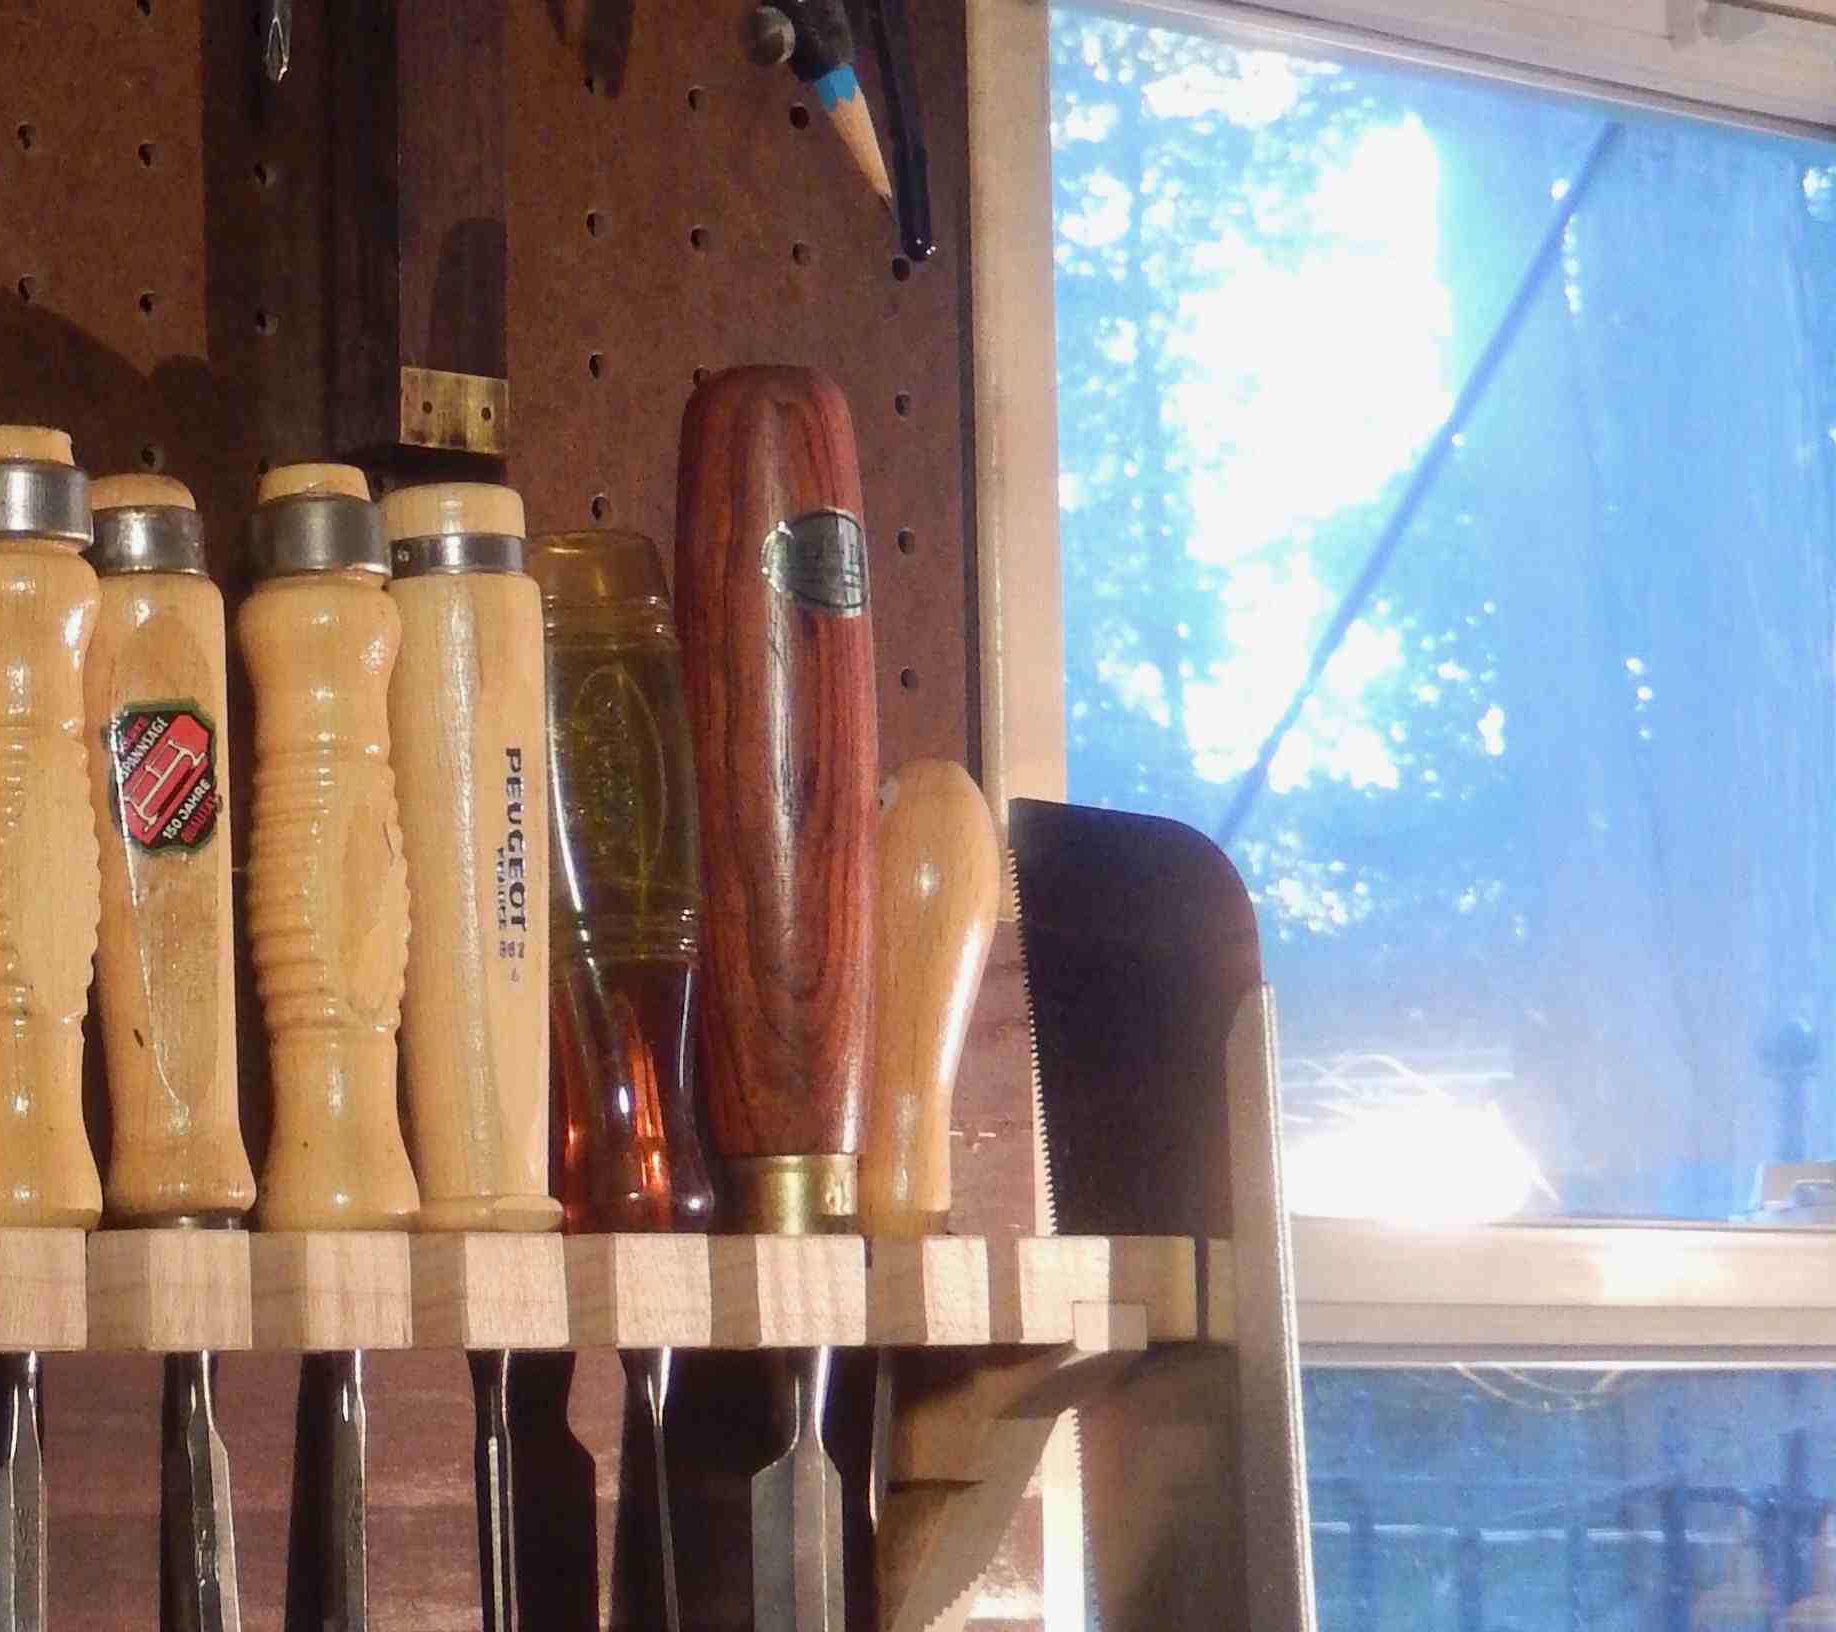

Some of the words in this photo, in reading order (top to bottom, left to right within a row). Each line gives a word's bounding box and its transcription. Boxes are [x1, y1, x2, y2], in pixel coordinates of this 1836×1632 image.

[162, 818, 183, 839] 150
[178, 778, 212, 821] JAHRE
[505, 747, 527, 932] PEUGEOT
